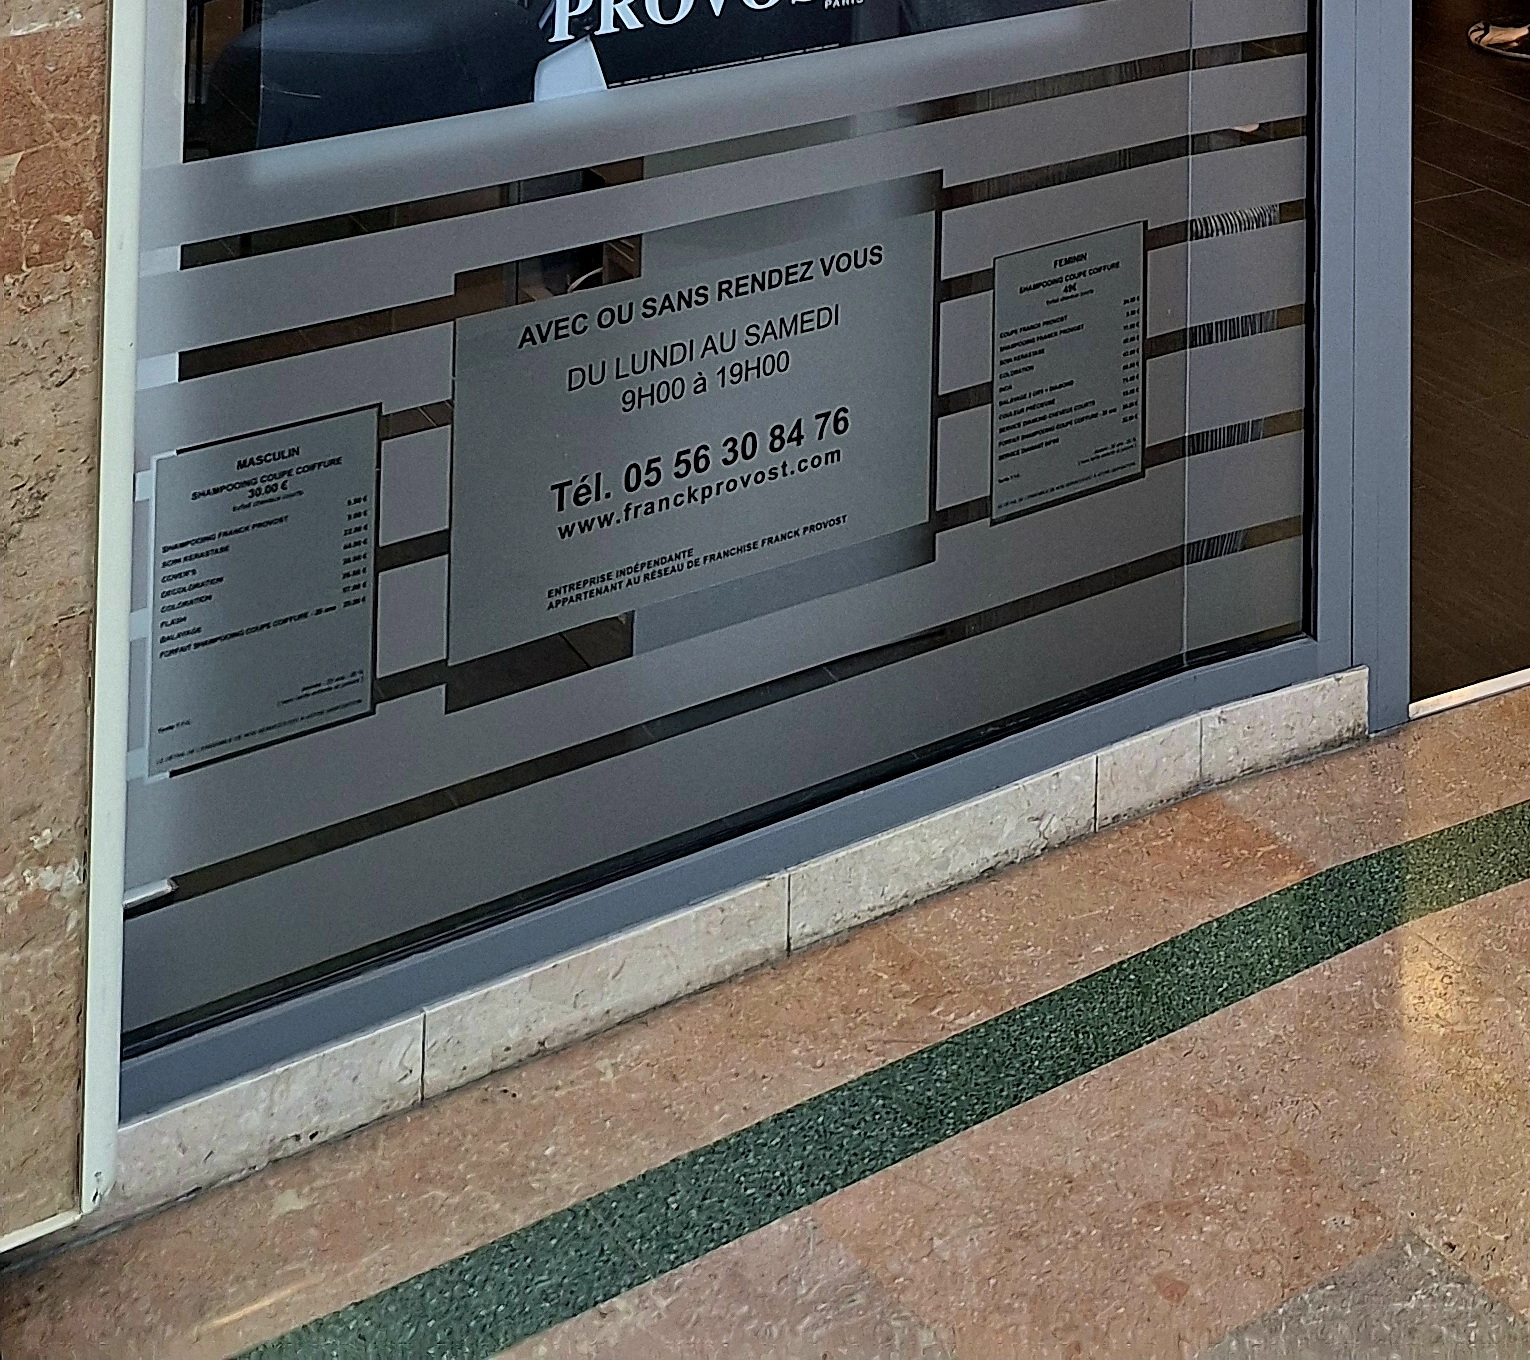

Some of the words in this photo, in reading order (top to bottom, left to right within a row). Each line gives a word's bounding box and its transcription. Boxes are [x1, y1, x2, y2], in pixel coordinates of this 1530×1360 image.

[518, 313, 588, 349] AVEC
[597, 302, 634, 330] OU
[642, 286, 708, 319] SANS
[717, 261, 813, 302] RENDEZ
[819, 245, 883, 277] VOUS
[567, 361, 606, 391] DU
[615, 339, 694, 379] LUNDI
[701, 329, 736, 358] AU
[745, 304, 839, 346] SAMEDI
[621, 379, 685, 413] 9H00
[693, 372, 708, 395] à
[716, 350, 790, 388] 19H00
[236, 446, 299, 470] MASCULIN
[551, 472, 611, 512] Tél.
[624, 457, 662, 493] 05
[673, 444, 711, 479] 56
[722, 431, 758, 465] 30
[769, 418, 804, 453] 84
[814, 407, 849, 440] 76
[558, 448, 841, 539] www.franckprovost.com
[547, 581, 624, 610] APPARTENANT
[626, 576, 641, 588] AU
[643, 564, 684, 582] RÉSEAU
[687, 558, 701, 570] DE
[703, 540, 759, 565] FRANCHISE
[761, 528, 800, 547] FRANCK
[802, 514, 848, 535] PROVOST
[547, 571, 613, 598] ENTREPRISE
[616, 548, 694, 579] INDÉPENDANTE
